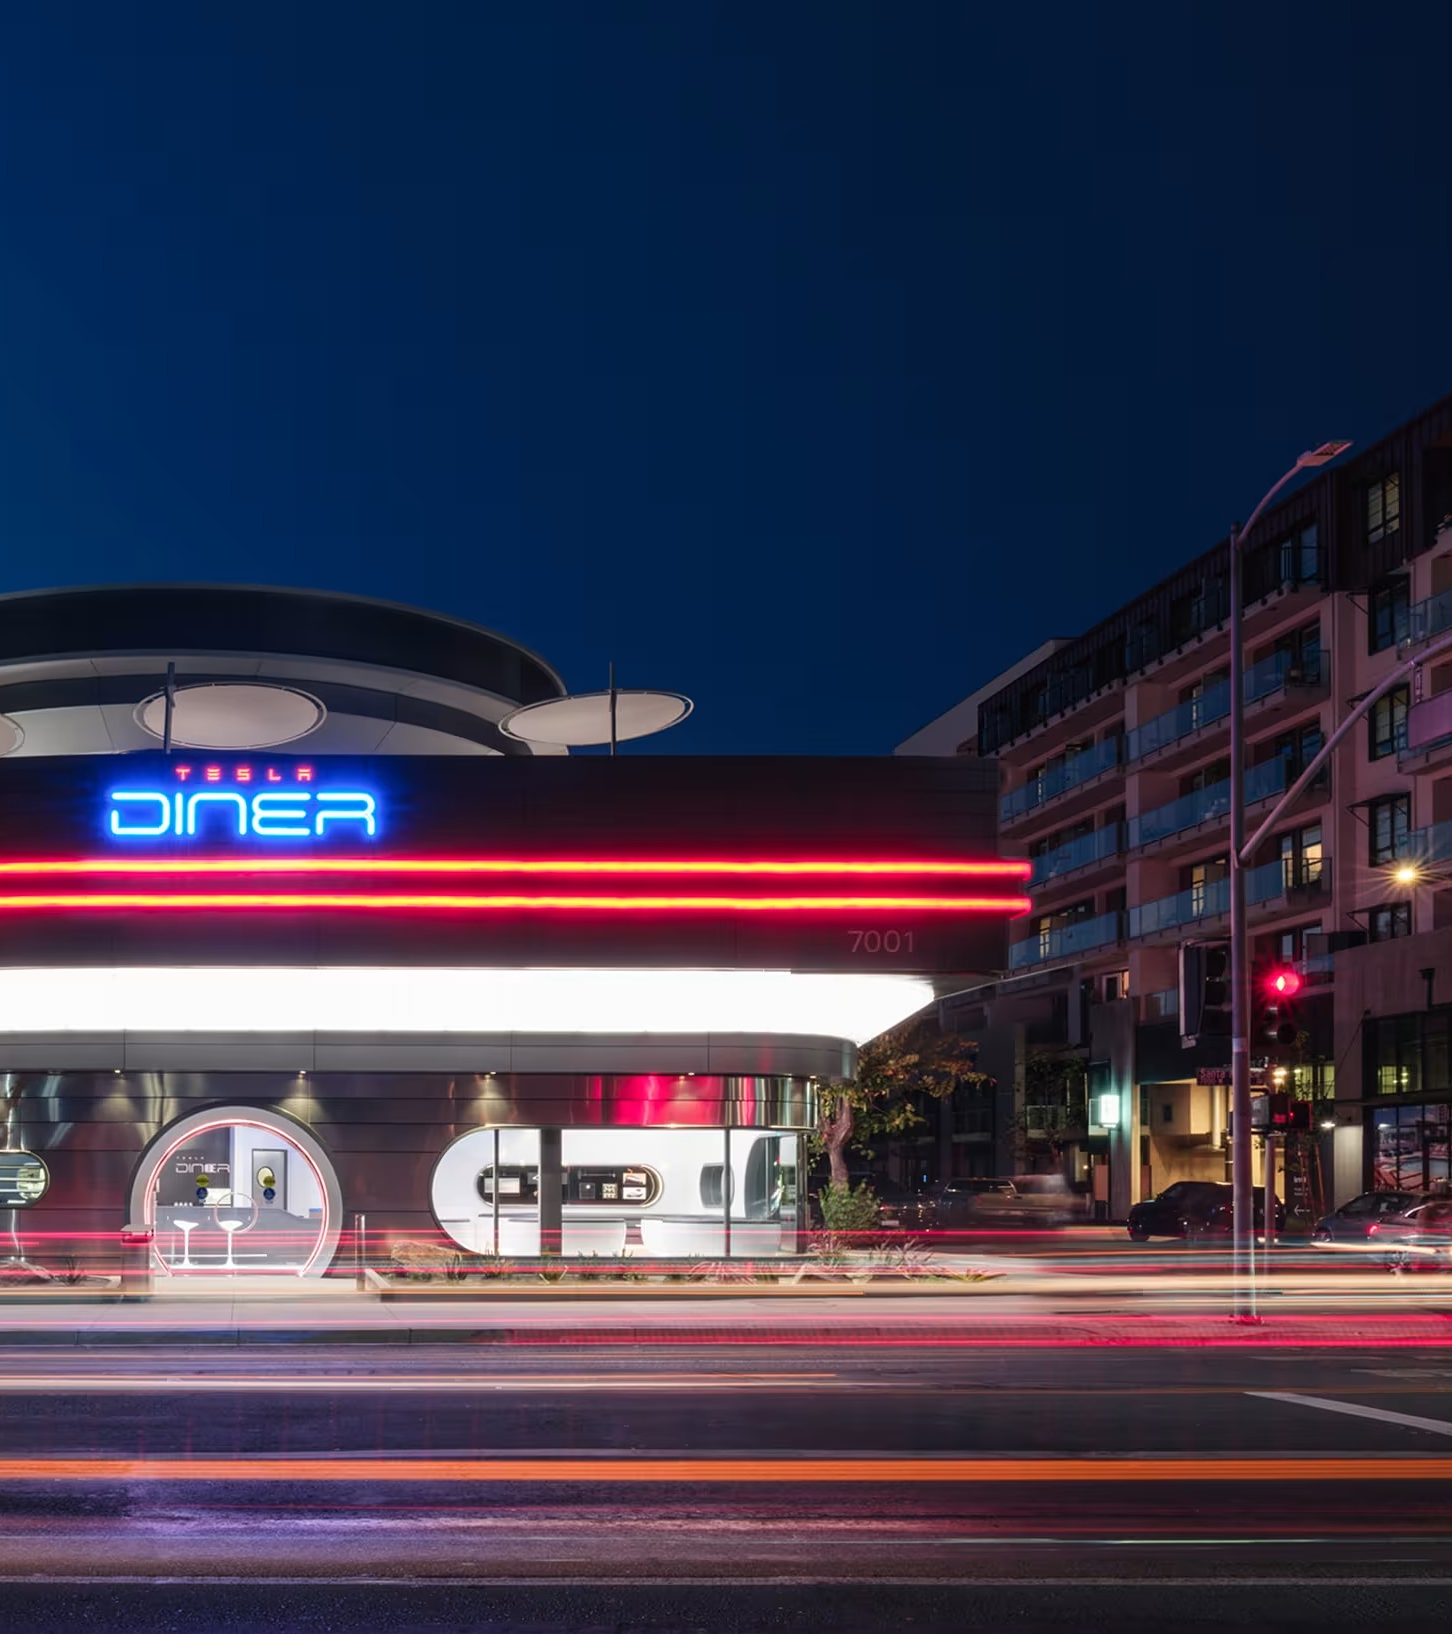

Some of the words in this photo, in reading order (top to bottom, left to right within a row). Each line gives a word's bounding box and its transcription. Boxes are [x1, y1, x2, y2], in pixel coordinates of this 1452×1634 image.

[175, 767, 312, 782] TESLA
[110, 792, 376, 836] DINER
[847, 929, 914, 953] 7001
[175, 1162, 231, 1174] DINER
